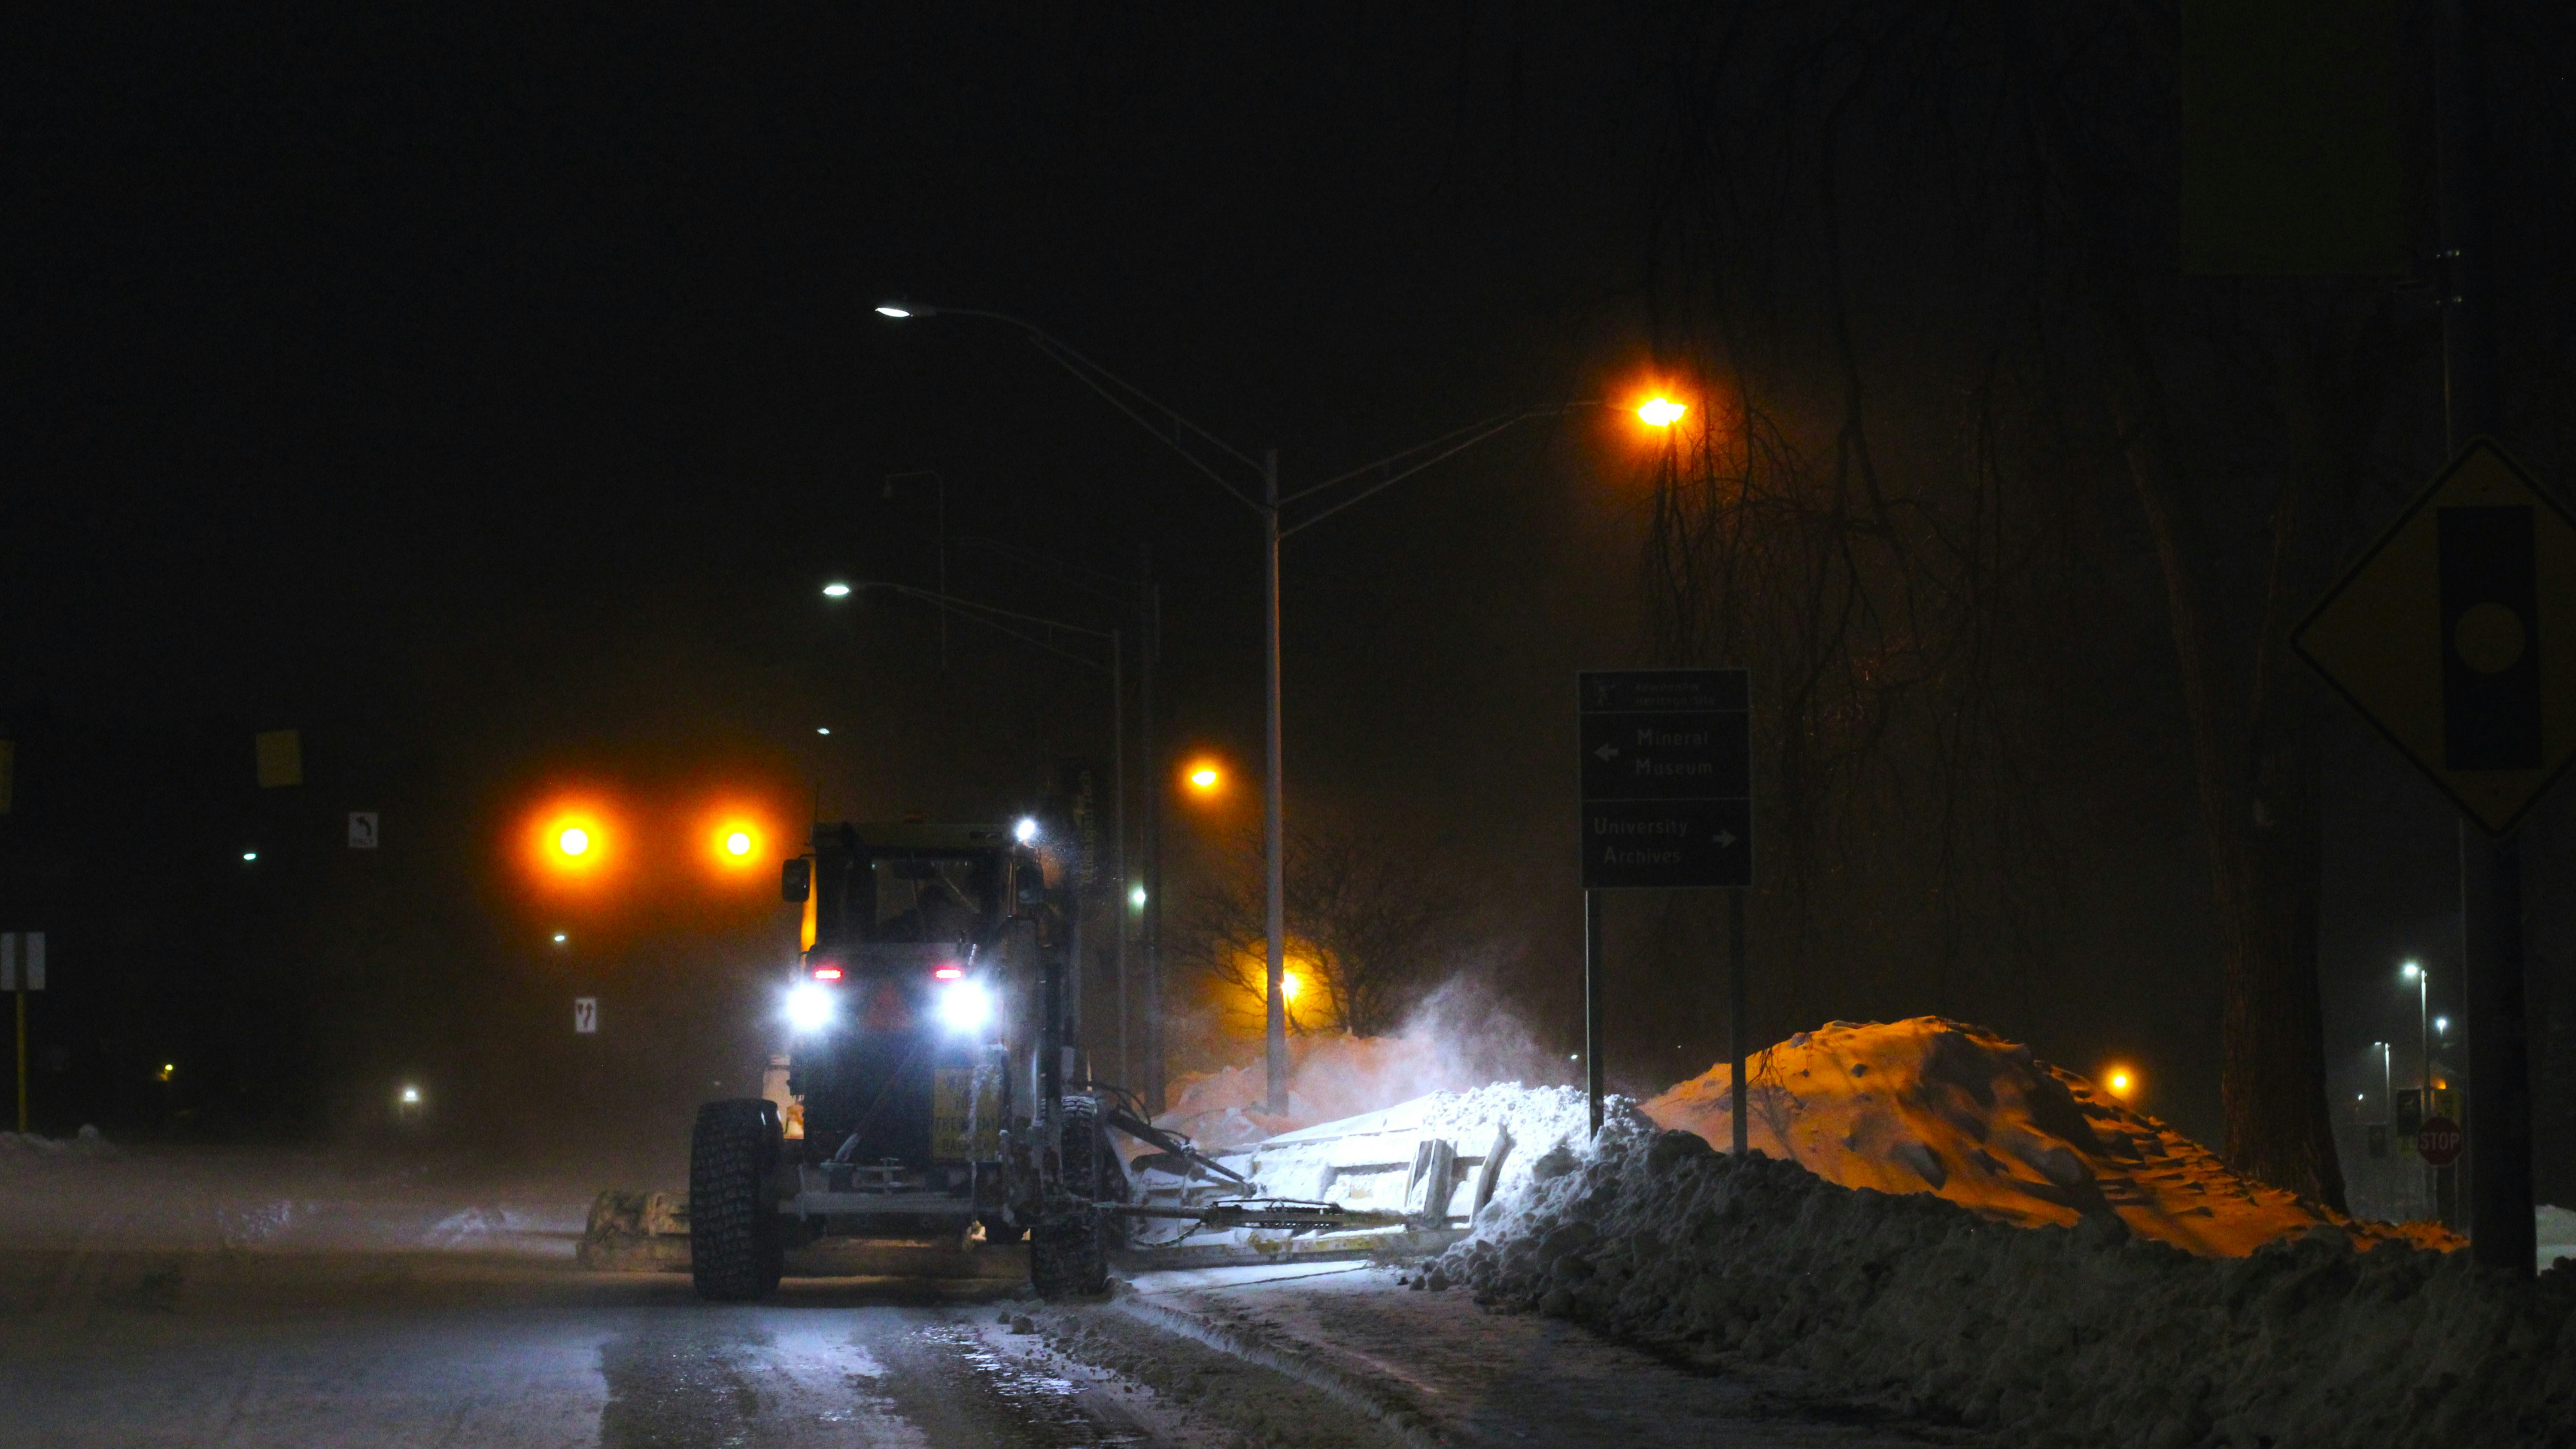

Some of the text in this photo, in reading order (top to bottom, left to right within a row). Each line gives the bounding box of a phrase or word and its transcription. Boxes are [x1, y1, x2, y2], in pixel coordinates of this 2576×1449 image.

[1637, 728, 1709, 746] Mineral
[1636, 757, 1712, 776] Museum
[1594, 817, 1688, 837] University
[1603, 845, 1681, 865] Archives
[2419, 1132, 2460, 1151] STOP
